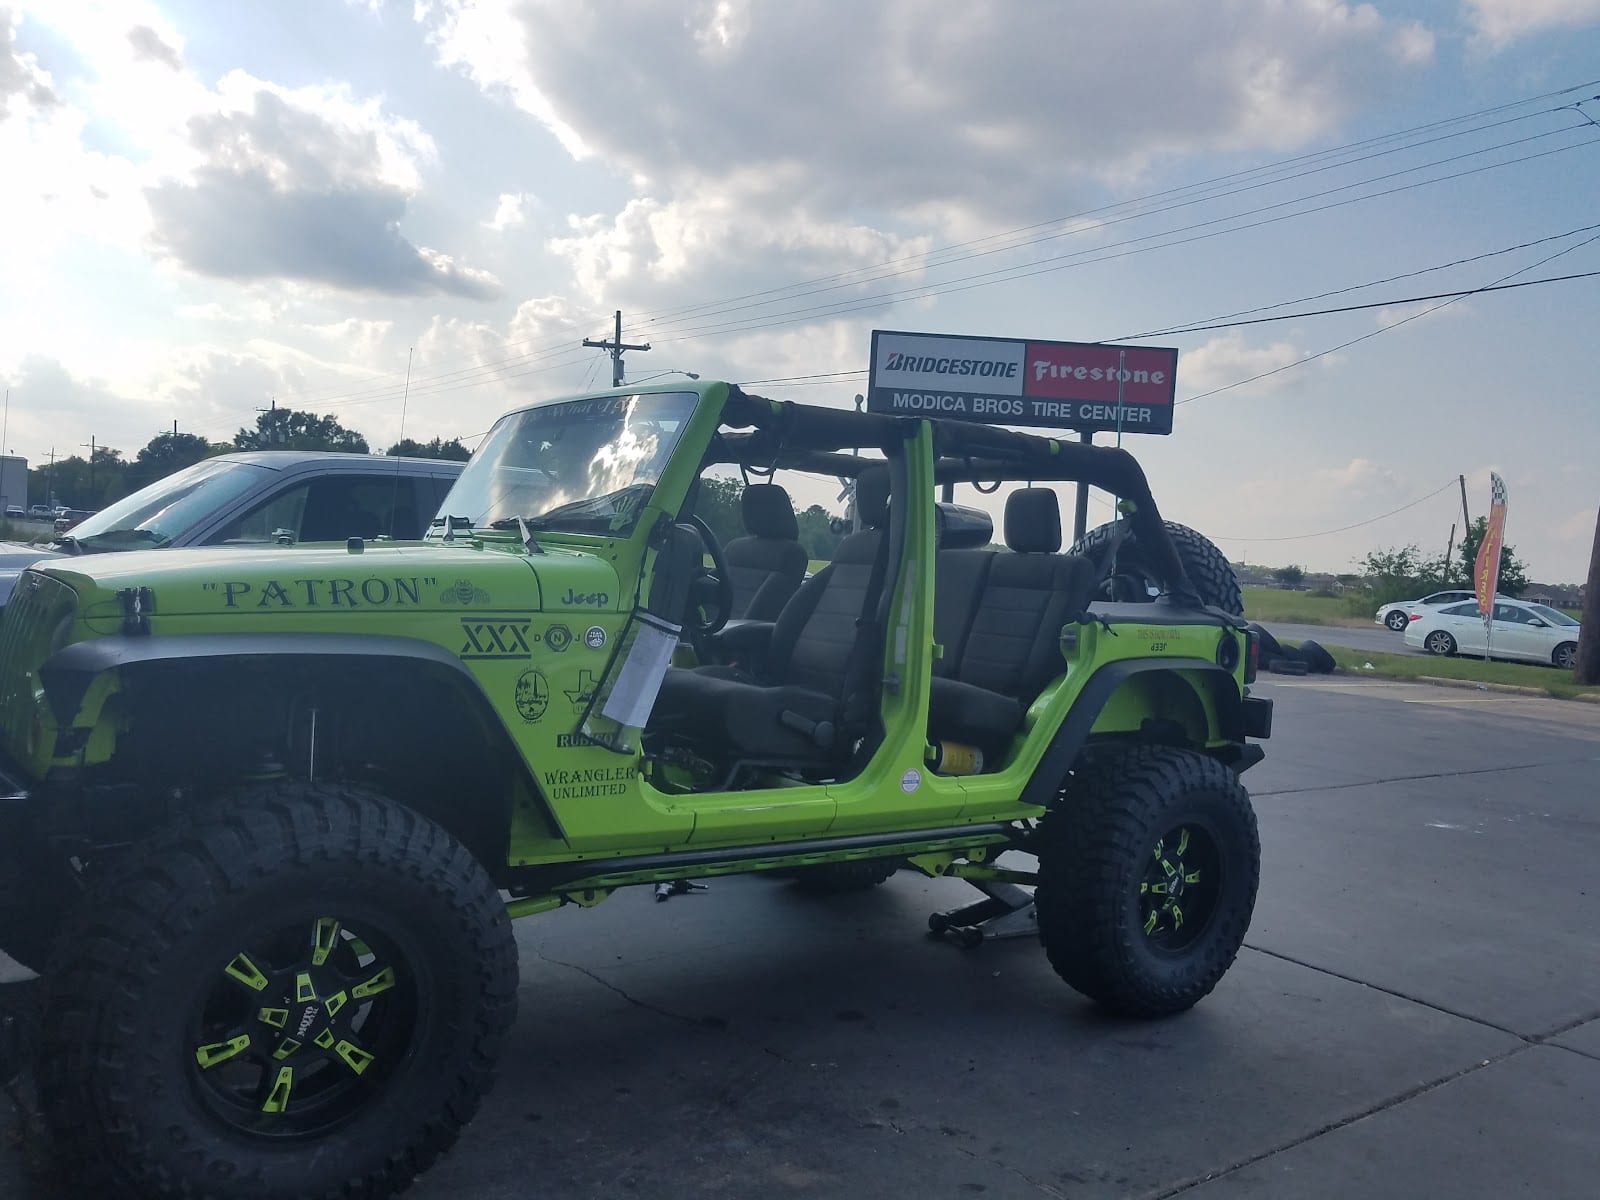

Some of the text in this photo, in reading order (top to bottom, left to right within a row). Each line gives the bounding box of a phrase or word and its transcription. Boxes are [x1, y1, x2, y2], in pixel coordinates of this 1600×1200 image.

[885, 352, 1166, 384] BRIDGESTONE Firestone
[893, 393, 1151, 423] MODICA BROS TIRE CENTER
[562, 588, 609, 608] Jeep
[462, 623, 530, 653] XXX
[544, 767, 636, 785] WRANGLER
[553, 783, 627, 800] UNLIMITED
